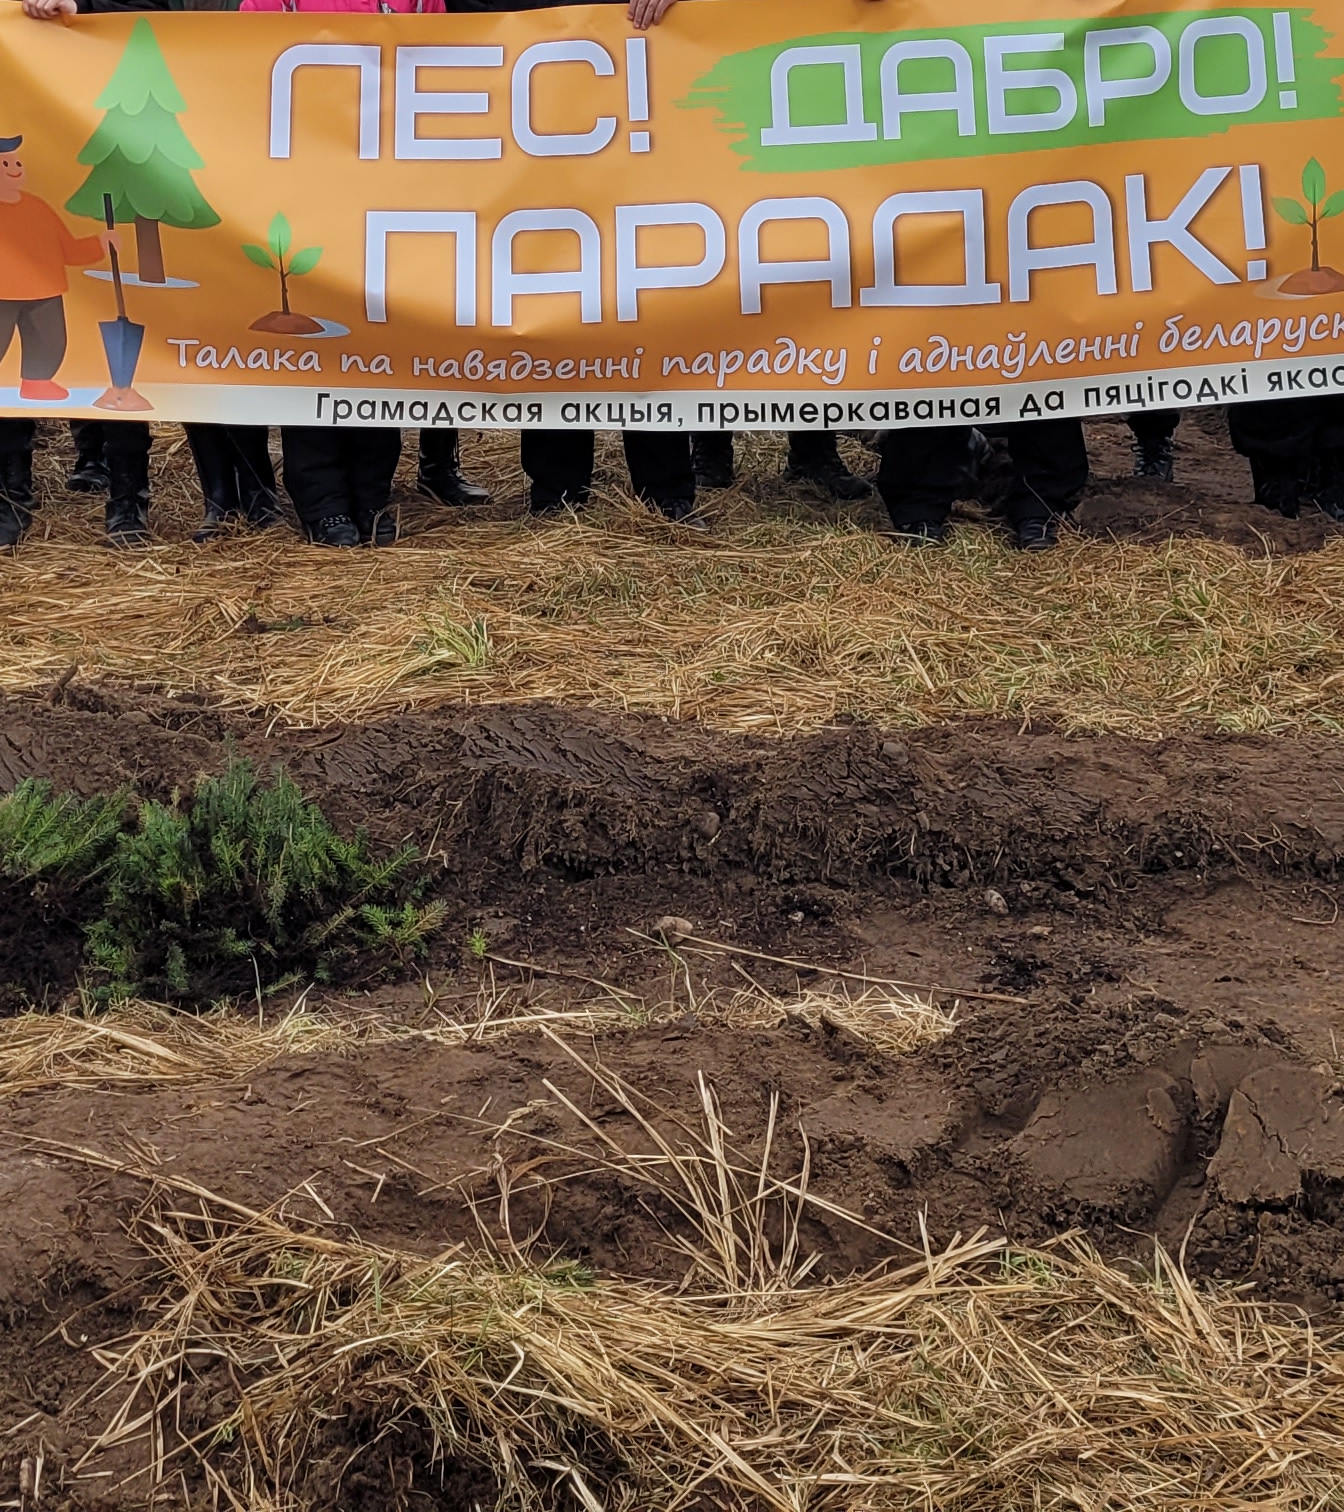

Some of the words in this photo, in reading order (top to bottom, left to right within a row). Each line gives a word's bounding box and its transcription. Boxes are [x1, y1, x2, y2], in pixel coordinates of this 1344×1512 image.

[268, 37, 651, 161] ЛЕС!
[760, 11, 1299, 147] ДАБРО!
[364, 164, 1268, 327] ПАРАДАК!
[167, 338, 321, 372] Талака
[340, 351, 393, 375] па
[413, 347, 645, 380] навядзенні
[662, 336, 847, 388] парадку
[867, 336, 883, 375] і
[899, 321, 1144, 379] аднаўленні
[316, 392, 544, 426] Грамадская
[560, 401, 684, 426] акцыя,
[697, 395, 1001, 430] прымеркаваная
[1019, 390, 1065, 418] да
[1084, 367, 1249, 410] пяцігодкі
